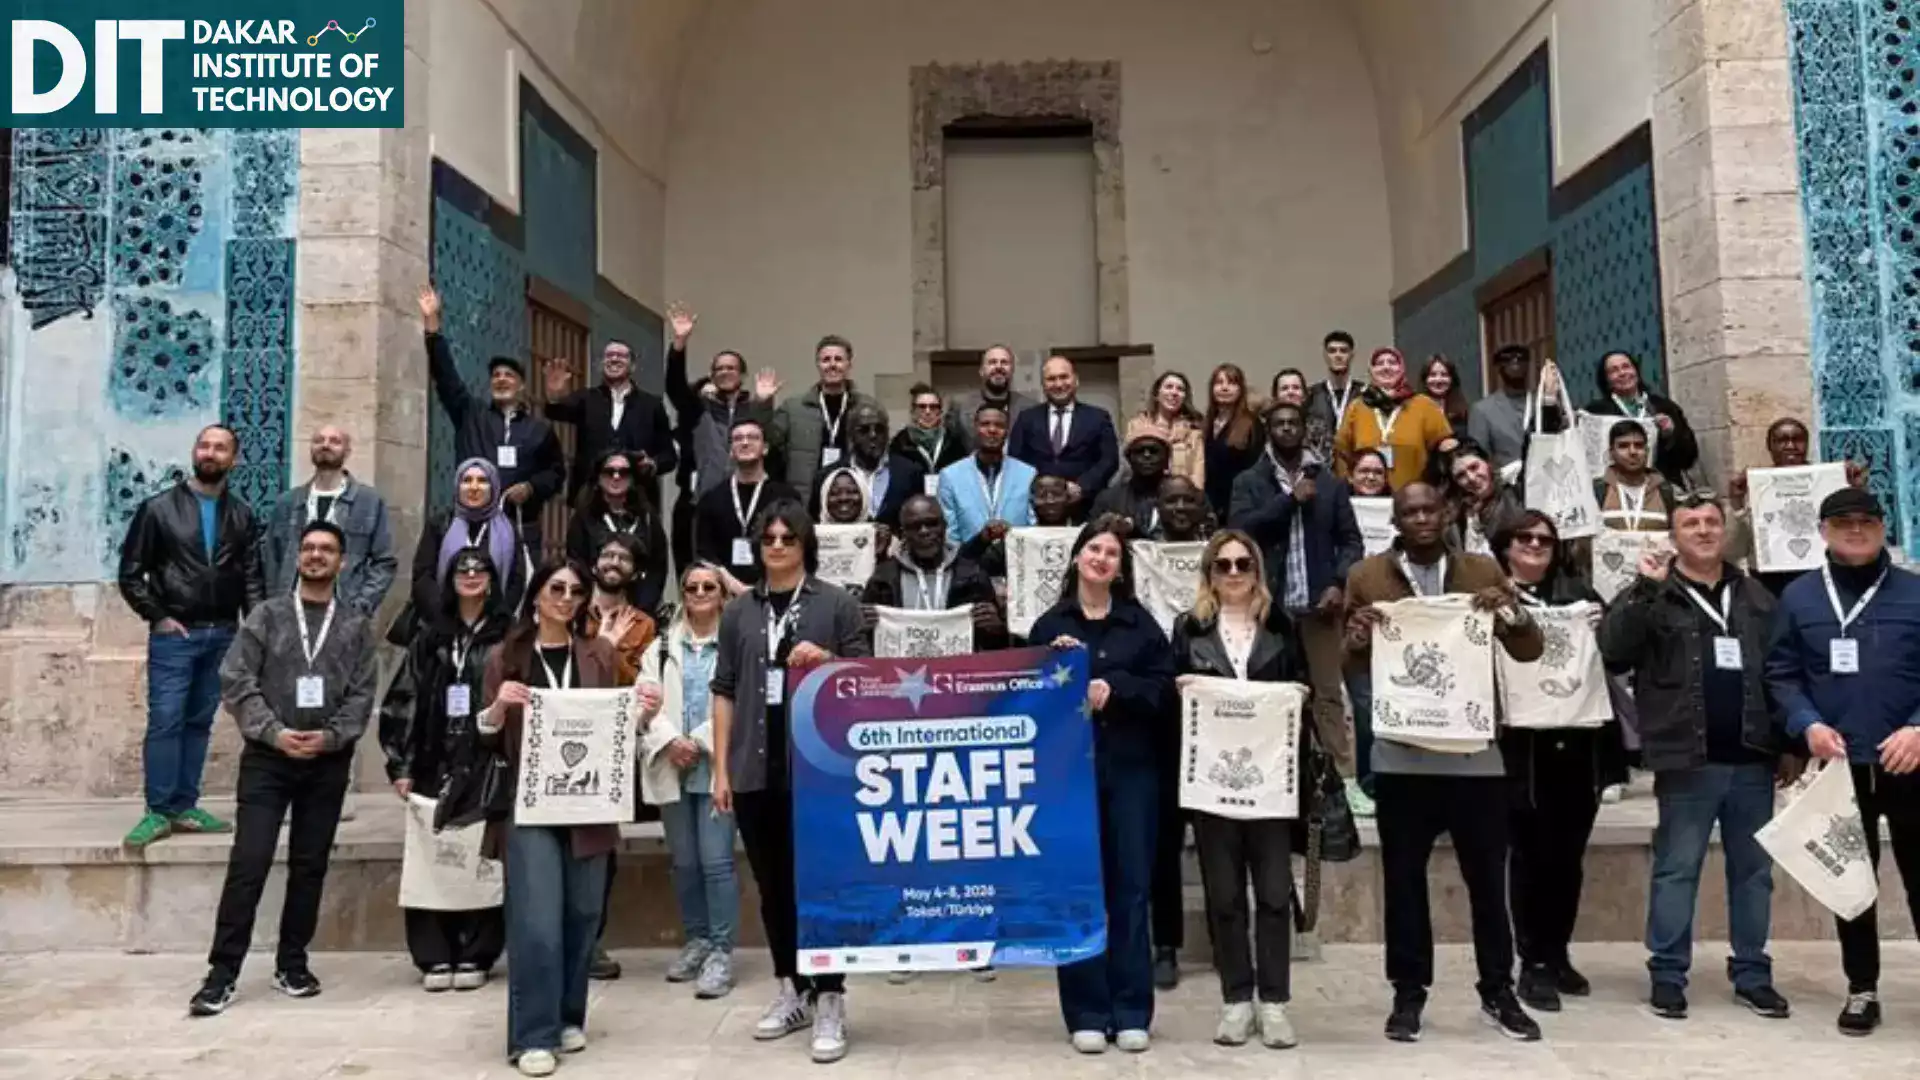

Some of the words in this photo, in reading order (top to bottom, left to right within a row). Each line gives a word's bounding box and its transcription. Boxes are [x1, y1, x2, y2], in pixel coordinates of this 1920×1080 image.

[956, 680, 1006, 694] Erasmus
[1009, 677, 1043, 691] Office
[859, 727, 891, 746] 6th
[898, 719, 1027, 744] International
[855, 749, 1036, 806] STAFF
[855, 804, 1041, 863] WEEK
[902, 887, 931, 902] May
